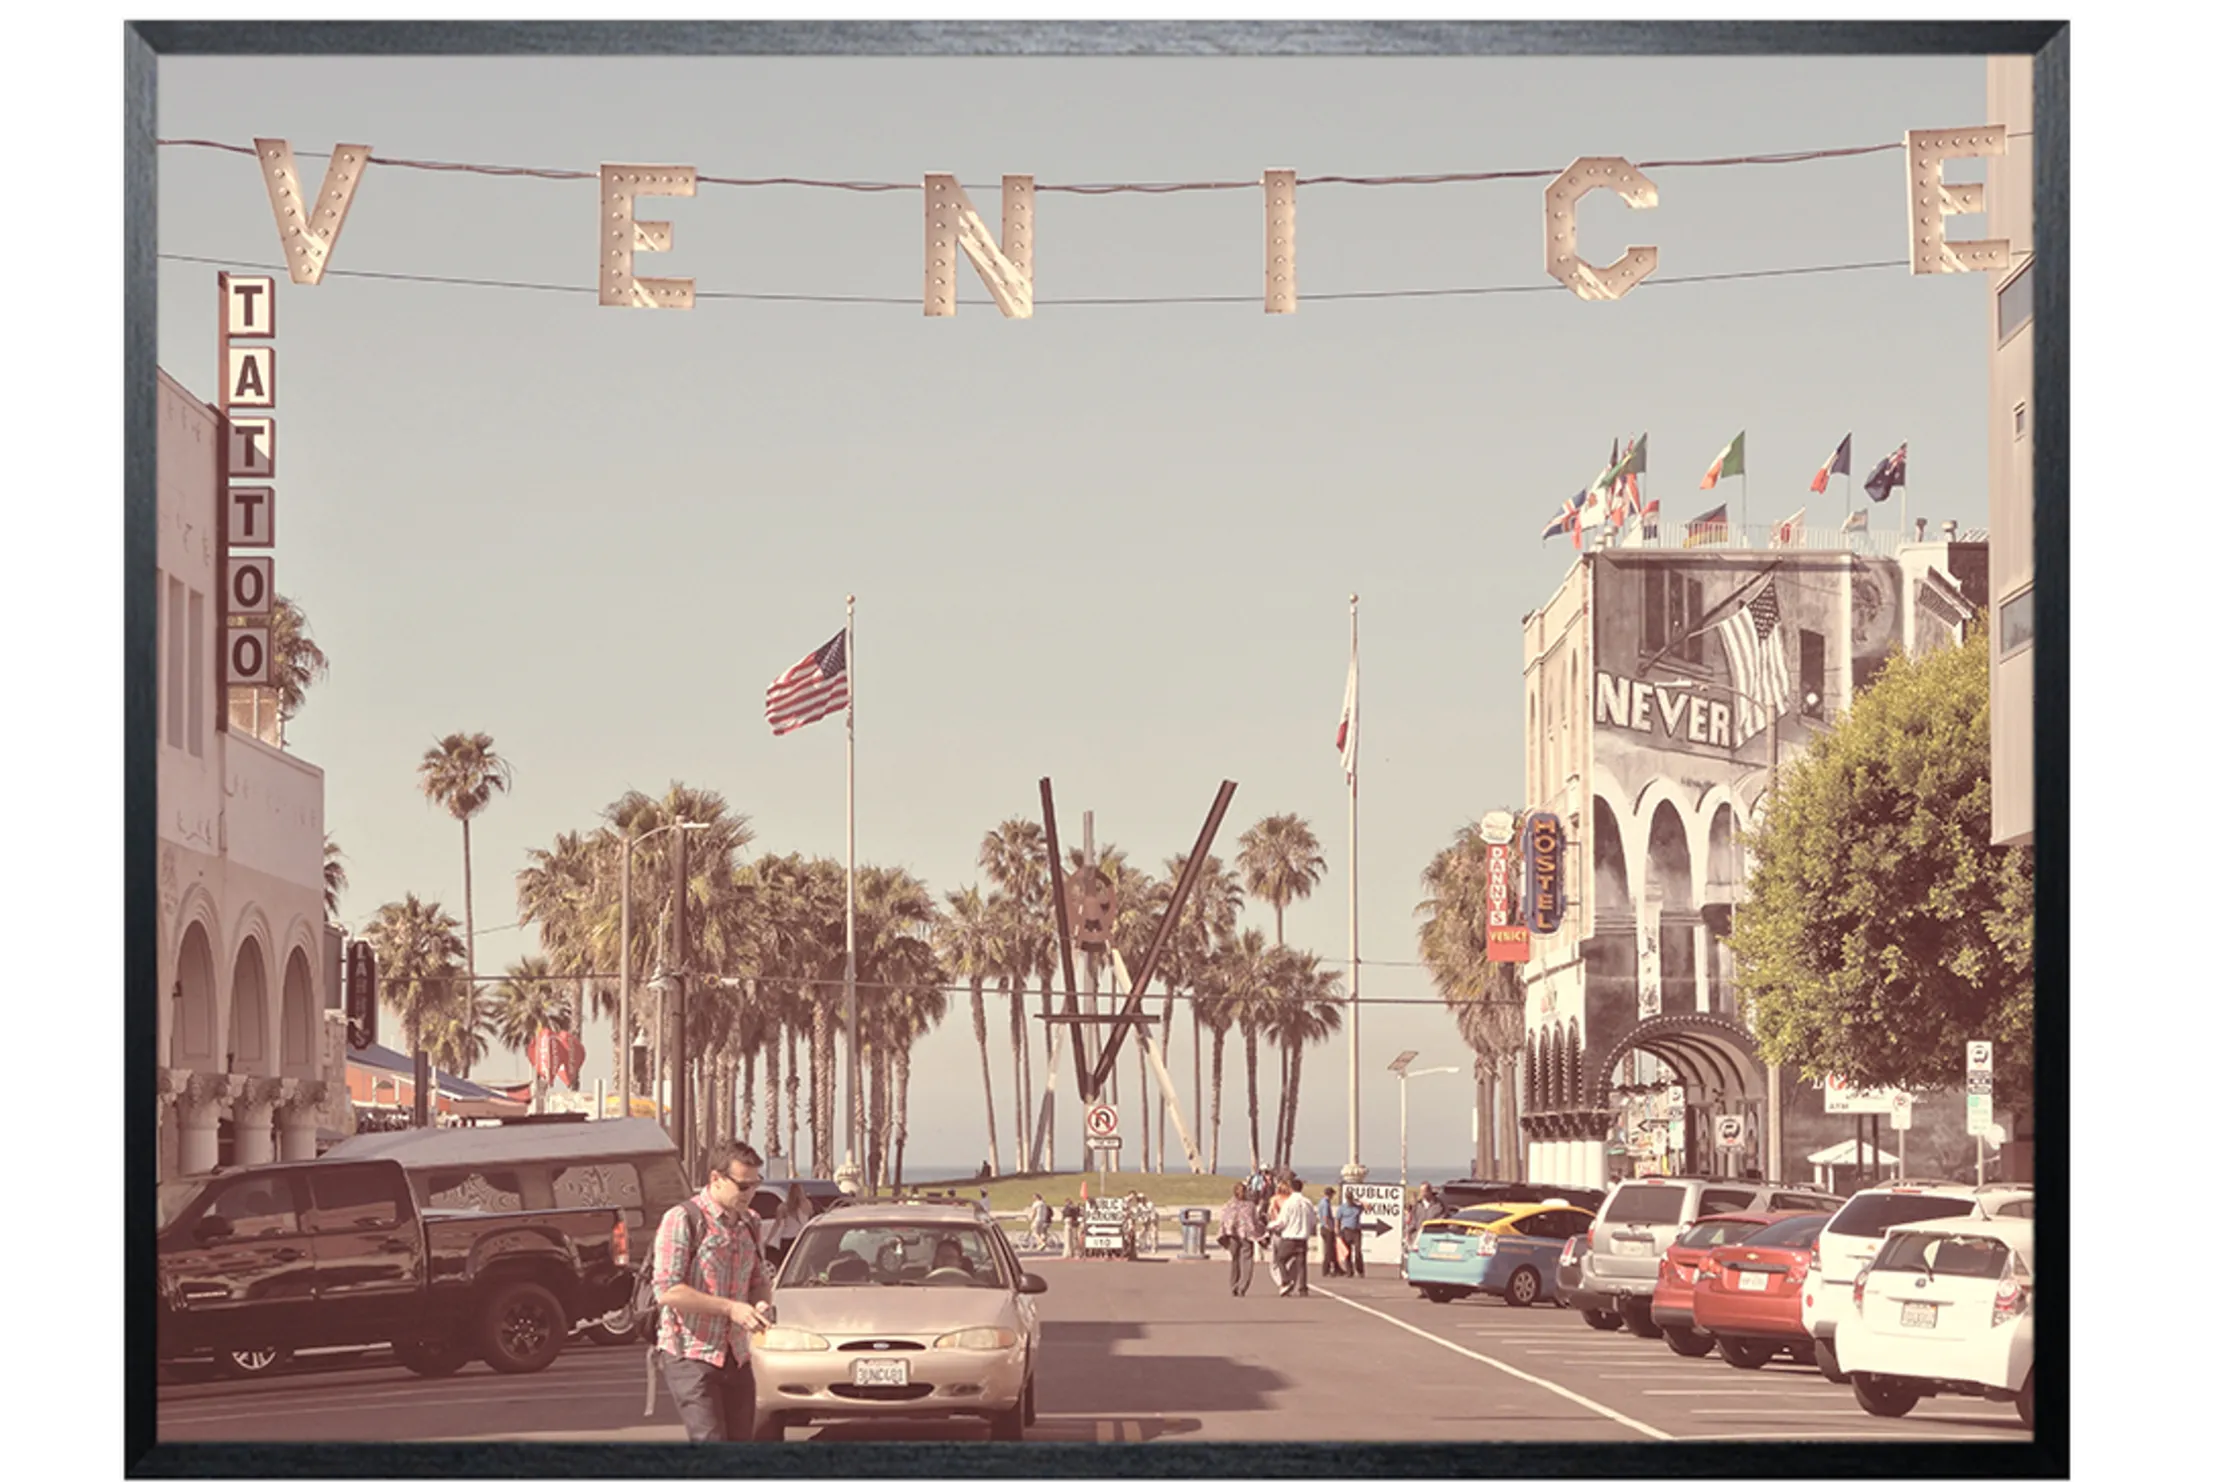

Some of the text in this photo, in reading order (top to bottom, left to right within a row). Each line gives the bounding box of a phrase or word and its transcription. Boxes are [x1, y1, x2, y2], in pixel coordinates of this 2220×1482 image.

[254, 126, 2010, 318] VENICE
[231, 284, 265, 679] TATTOO
[1595, 671, 1731, 748] NEVER
[1532, 819, 1557, 930] HOSTEL
[1346, 1186, 1400, 1200] PUBLIC
